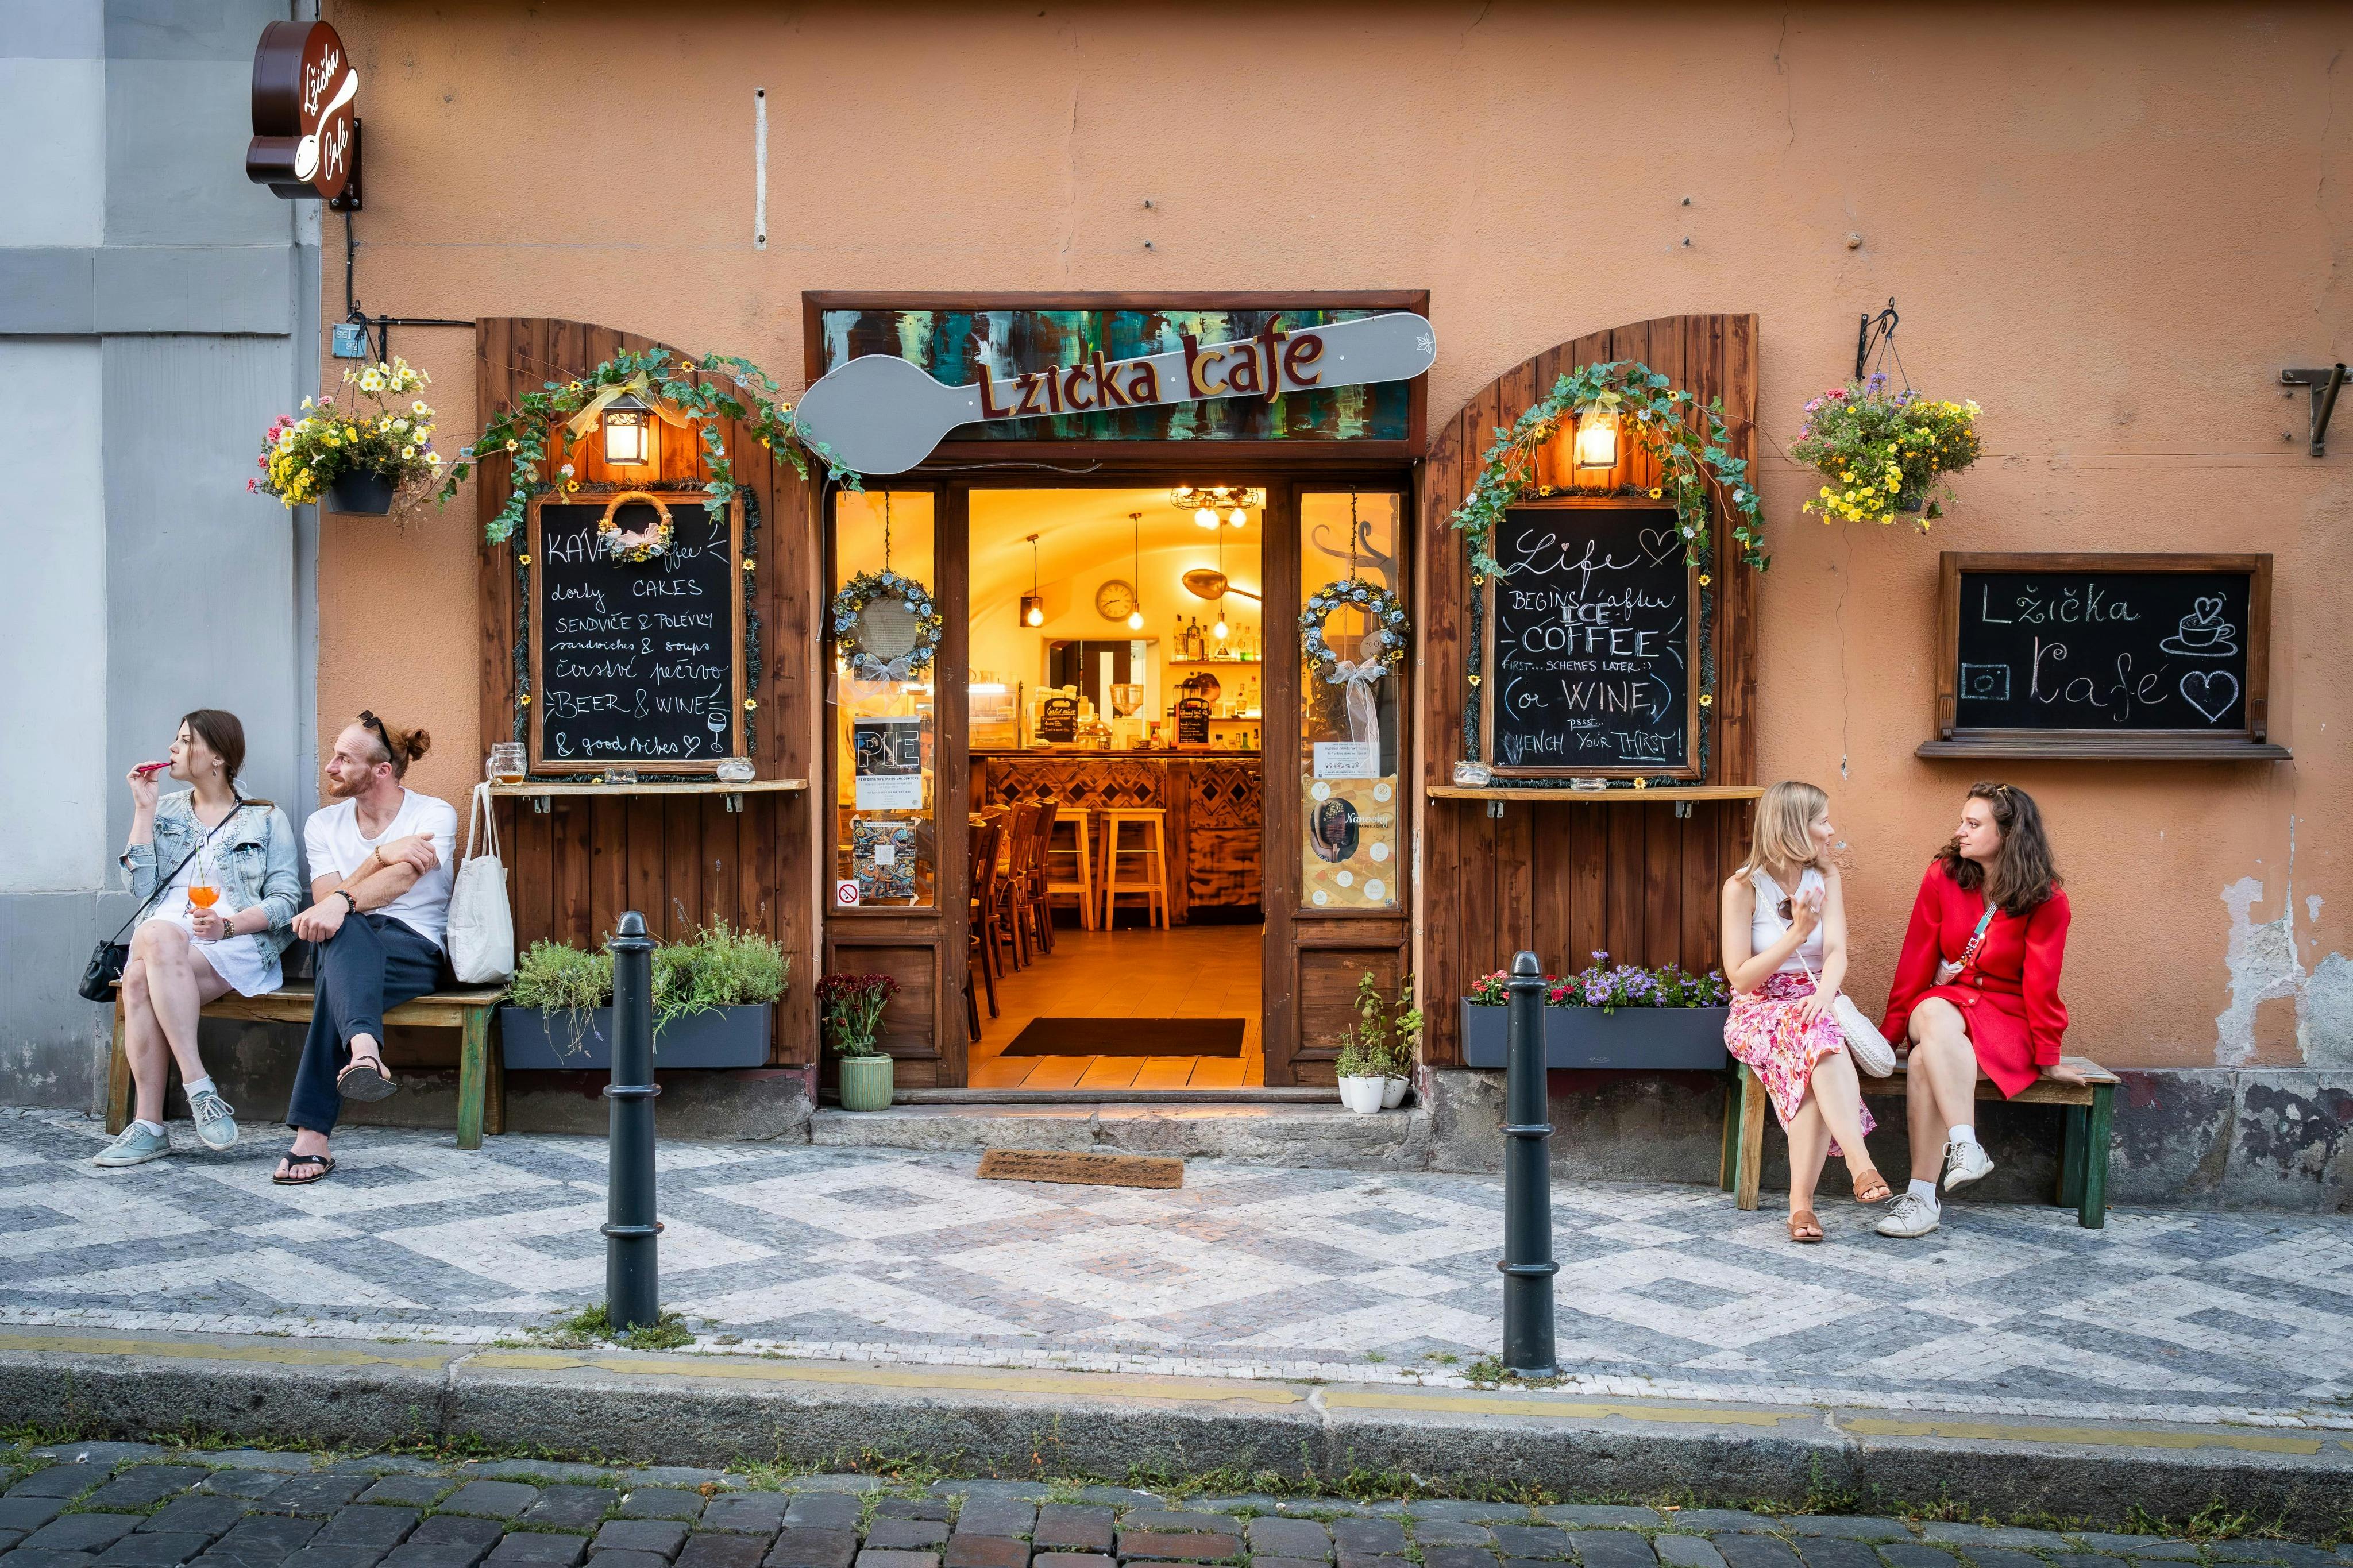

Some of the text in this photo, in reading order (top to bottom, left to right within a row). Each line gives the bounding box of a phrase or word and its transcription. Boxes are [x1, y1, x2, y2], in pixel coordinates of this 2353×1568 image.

[304, 43, 338, 117] Lžička
[325, 117, 348, 180] Café
[1506, 528, 1641, 601] Life
[551, 578, 703, 613] dorty CAKES
[1509, 587, 1676, 621] BEGINS after
[1981, 582, 2141, 624] Lžička
[555, 610, 713, 632] SENDVIČE & POLÉVKY
[1560, 603, 1613, 625] ICE
[549, 638, 710, 656] sandwiches & soups
[1522, 622, 1660, 657] COFFEE
[556, 655, 728, 686] čerstvé pečivo
[553, 689, 709, 719] BEER & WINE
[556, 732, 574, 757] &
[581, 736, 627, 756] good
[857, 731, 919, 767] PIE
[1576, 732, 1612, 751] YOUR
